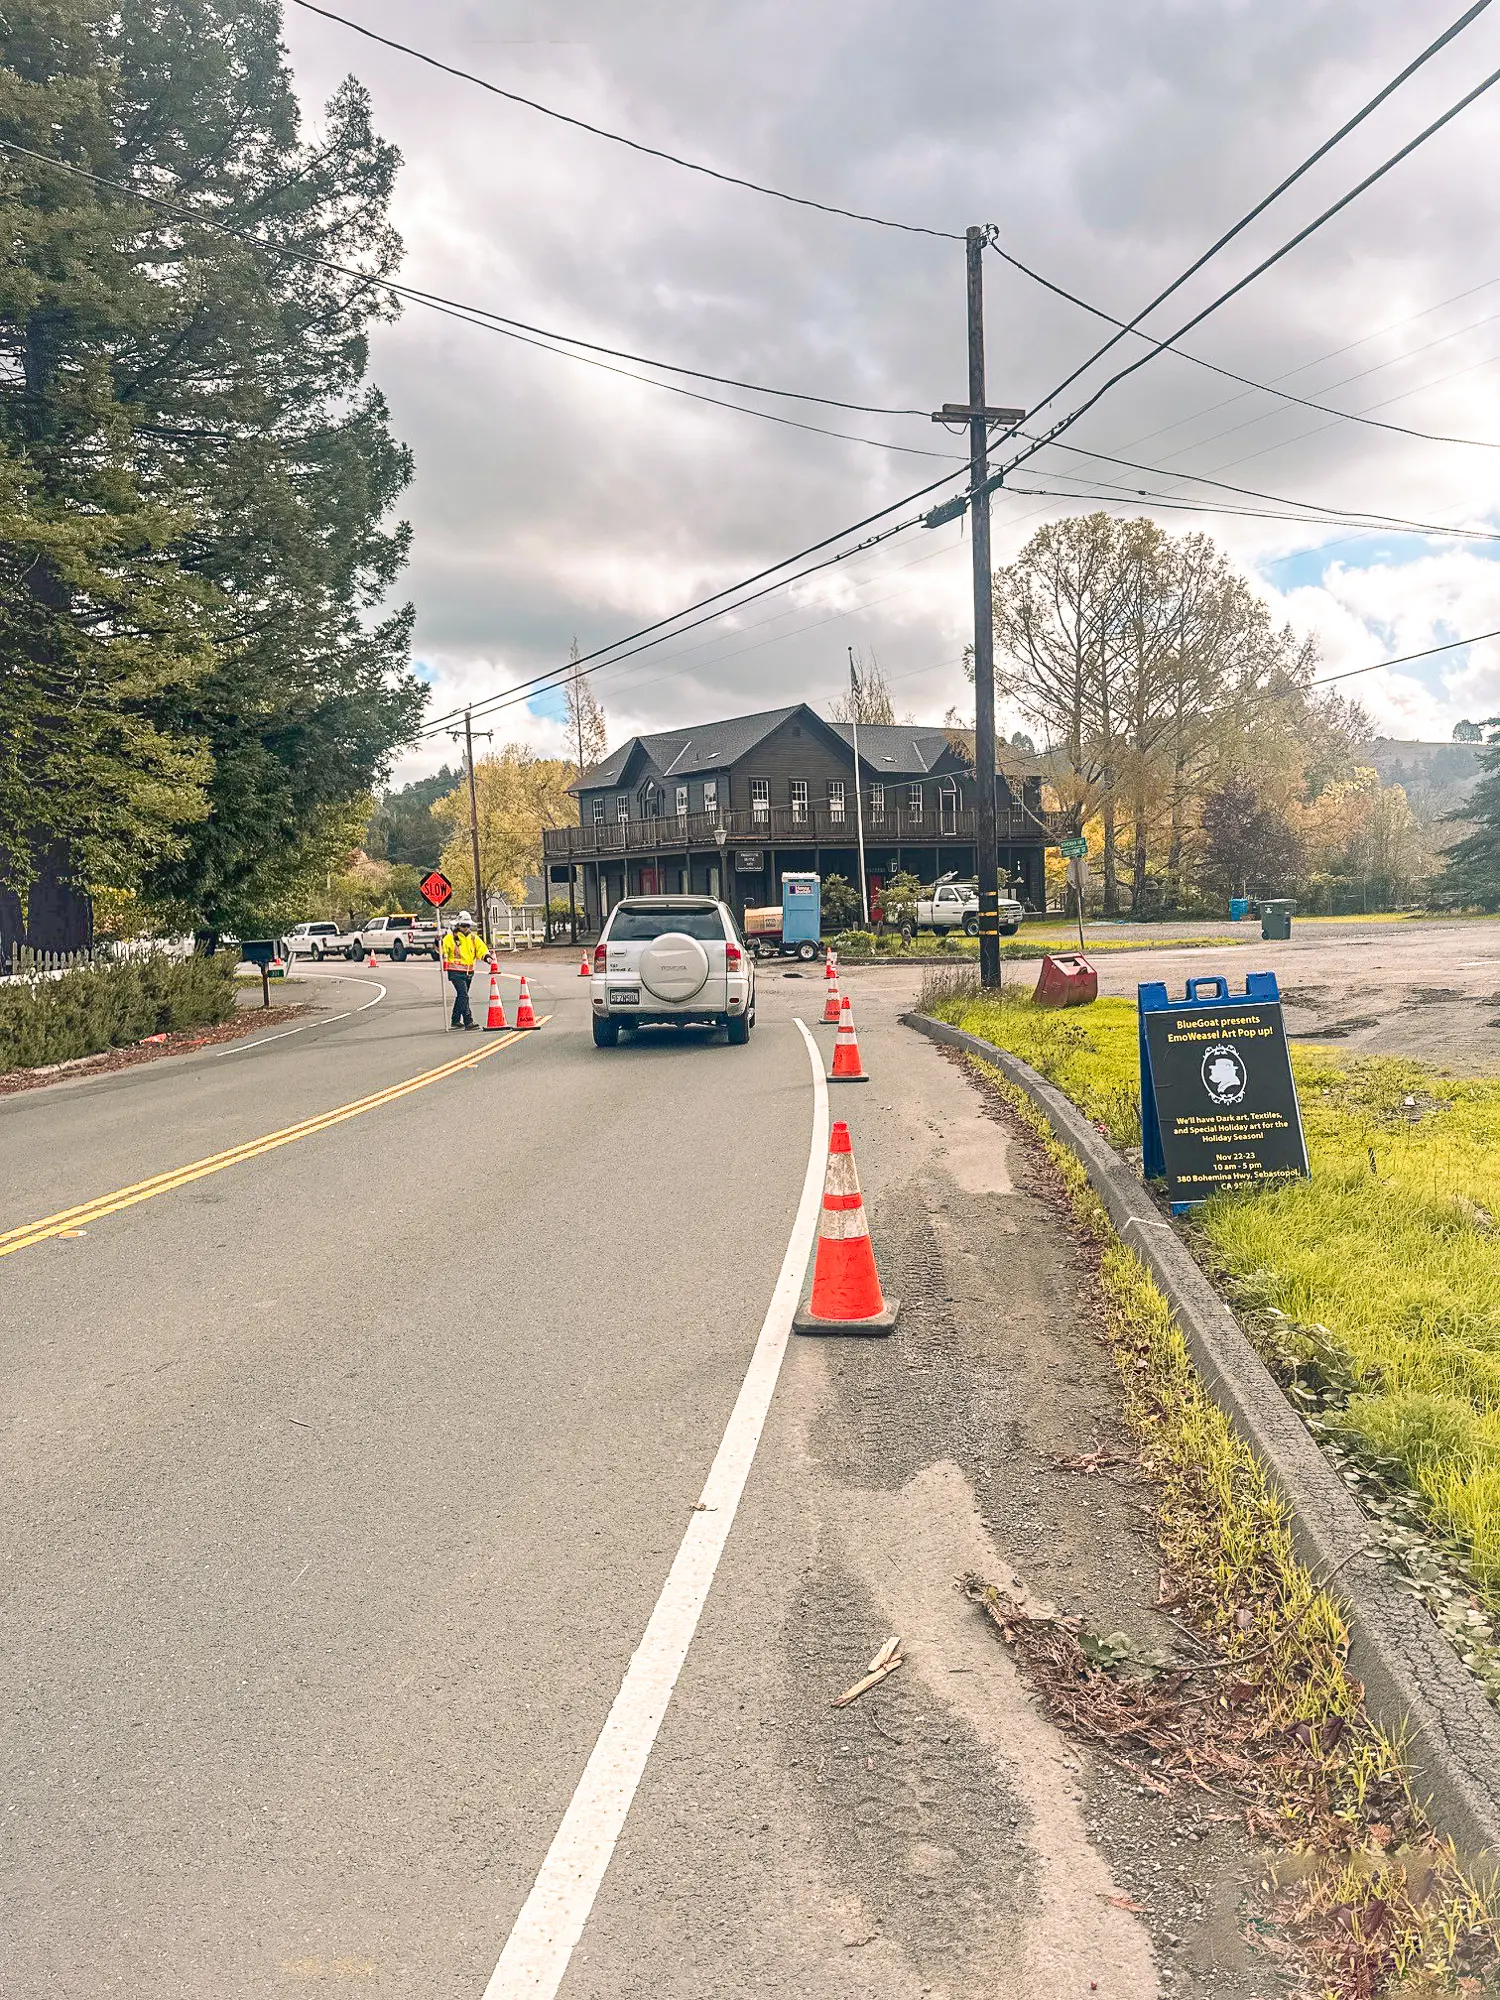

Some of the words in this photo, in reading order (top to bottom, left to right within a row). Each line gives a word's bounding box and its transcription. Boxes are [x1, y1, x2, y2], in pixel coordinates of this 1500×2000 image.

[424, 882, 447, 897] SLOW
[1176, 1018, 1220, 1029] BlueGoat
[1221, 1015, 1261, 1028] presents
[1167, 1030, 1220, 1043] EmoWeasel
[1221, 1029, 1237, 1039] Art
[1238, 1028, 1256, 1038] Pop
[1257, 1026, 1274, 1037] up!
[1176, 1116, 1196, 1125] We'll
[1196, 1116, 1215, 1124] have
[1216, 1114, 1235, 1122] Dark
[1236, 1113, 1250, 1121] art,
[1173, 1126, 1189, 1135] and
[1189, 1125, 1217, 1135] Special
[1218, 1123, 1248, 1132] Holiday
[1262, 1121, 1274, 1129] for
[1274, 1120, 1288, 1128] the
[1202, 1134, 1232, 1143] Holiday
[1232, 1132, 1264, 1141] Season!
[1215, 1153, 1232, 1161] Nov
[1233, 1152, 1256, 1160] 22-23
[1213, 1163, 1223, 1171] 10
[1224, 1163, 1237, 1171] am
[1242, 1162, 1248, 1170] 5
[1248, 1161, 1262, 1171] pm
[1176, 1175, 1192, 1183] 380
[1233, 1171, 1253, 1180] Hwy,
[1220, 1182, 1232, 1191] CA
